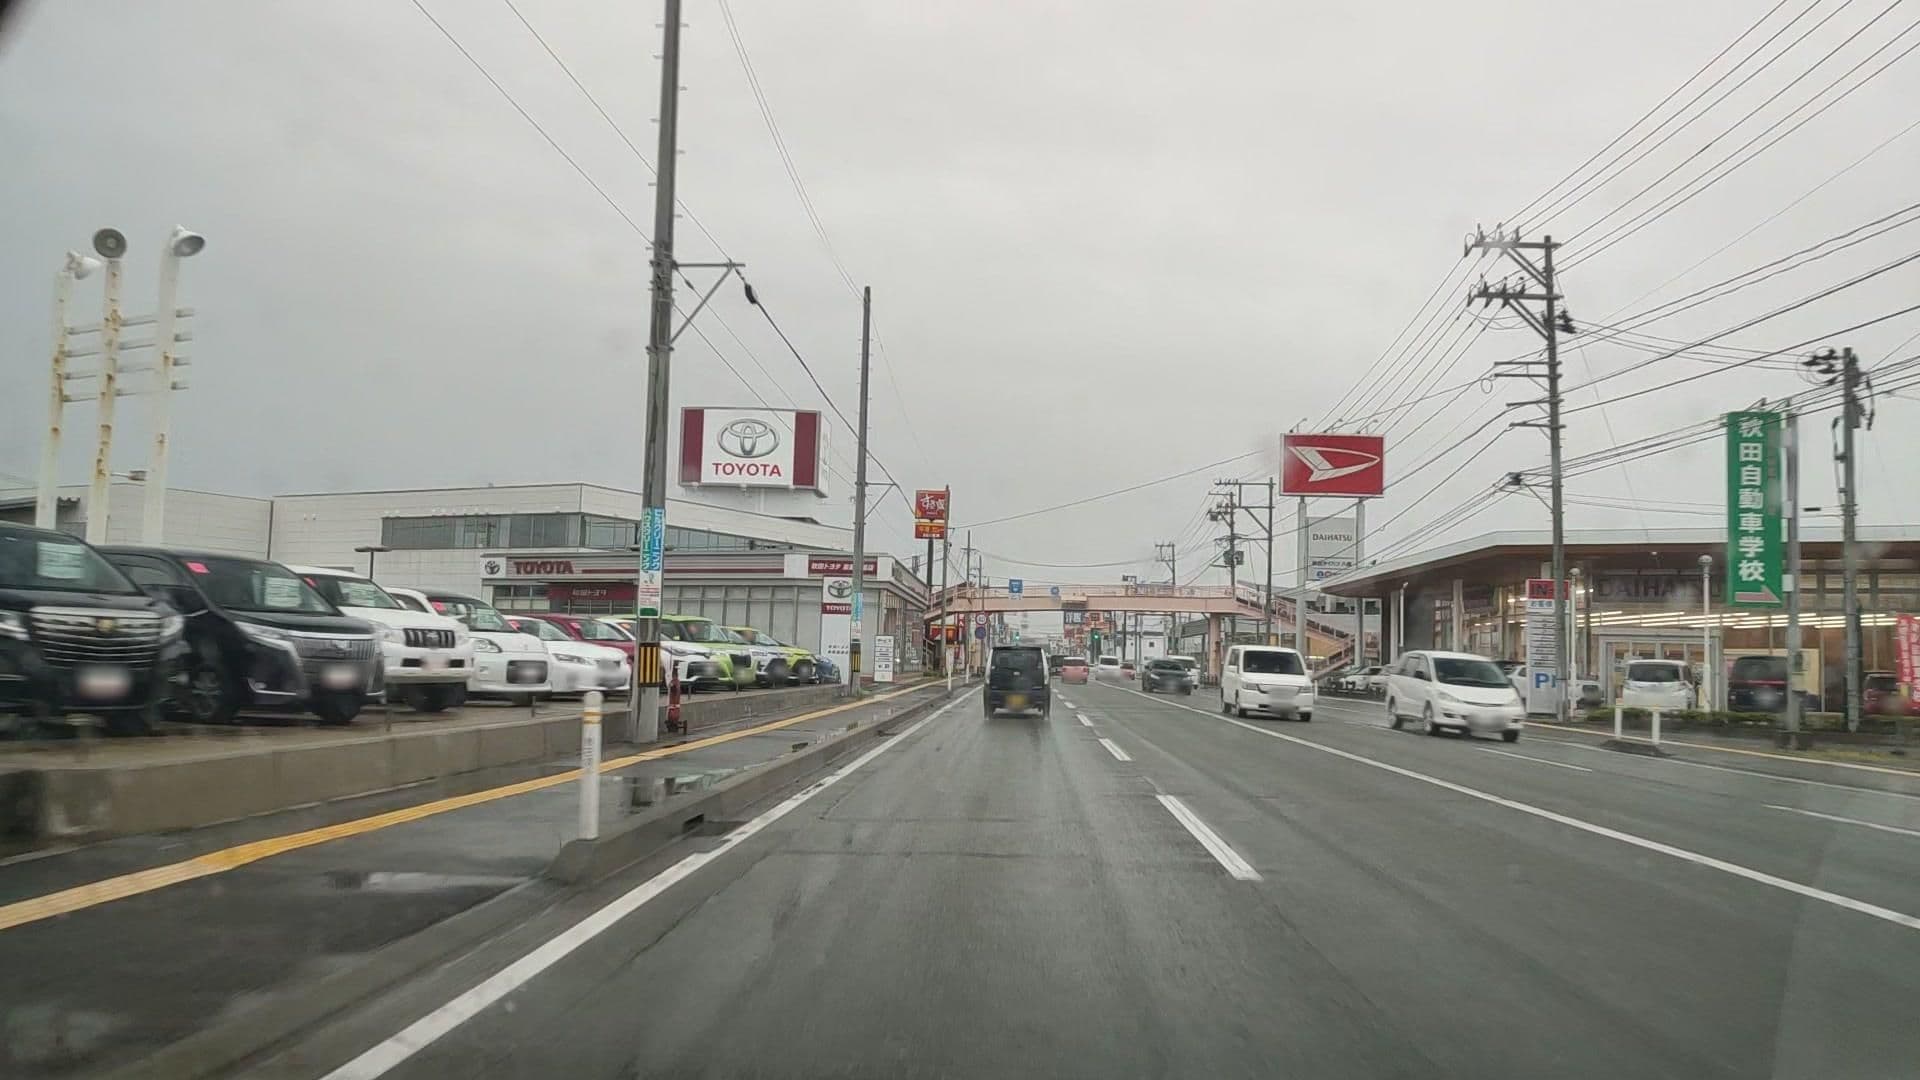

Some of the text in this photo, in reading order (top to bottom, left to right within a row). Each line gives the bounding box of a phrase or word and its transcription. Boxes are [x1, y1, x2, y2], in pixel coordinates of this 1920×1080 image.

[712, 462, 782, 478] TOYOTA
[1738, 416, 1765, 582] 秋田自動車学校
[1312, 533, 1353, 542] DAIHATSU
[513, 560, 574, 575] TOYOTA
[1600, 579, 1722, 598] DAIHAU
[1535, 673, 1549, 688] P
